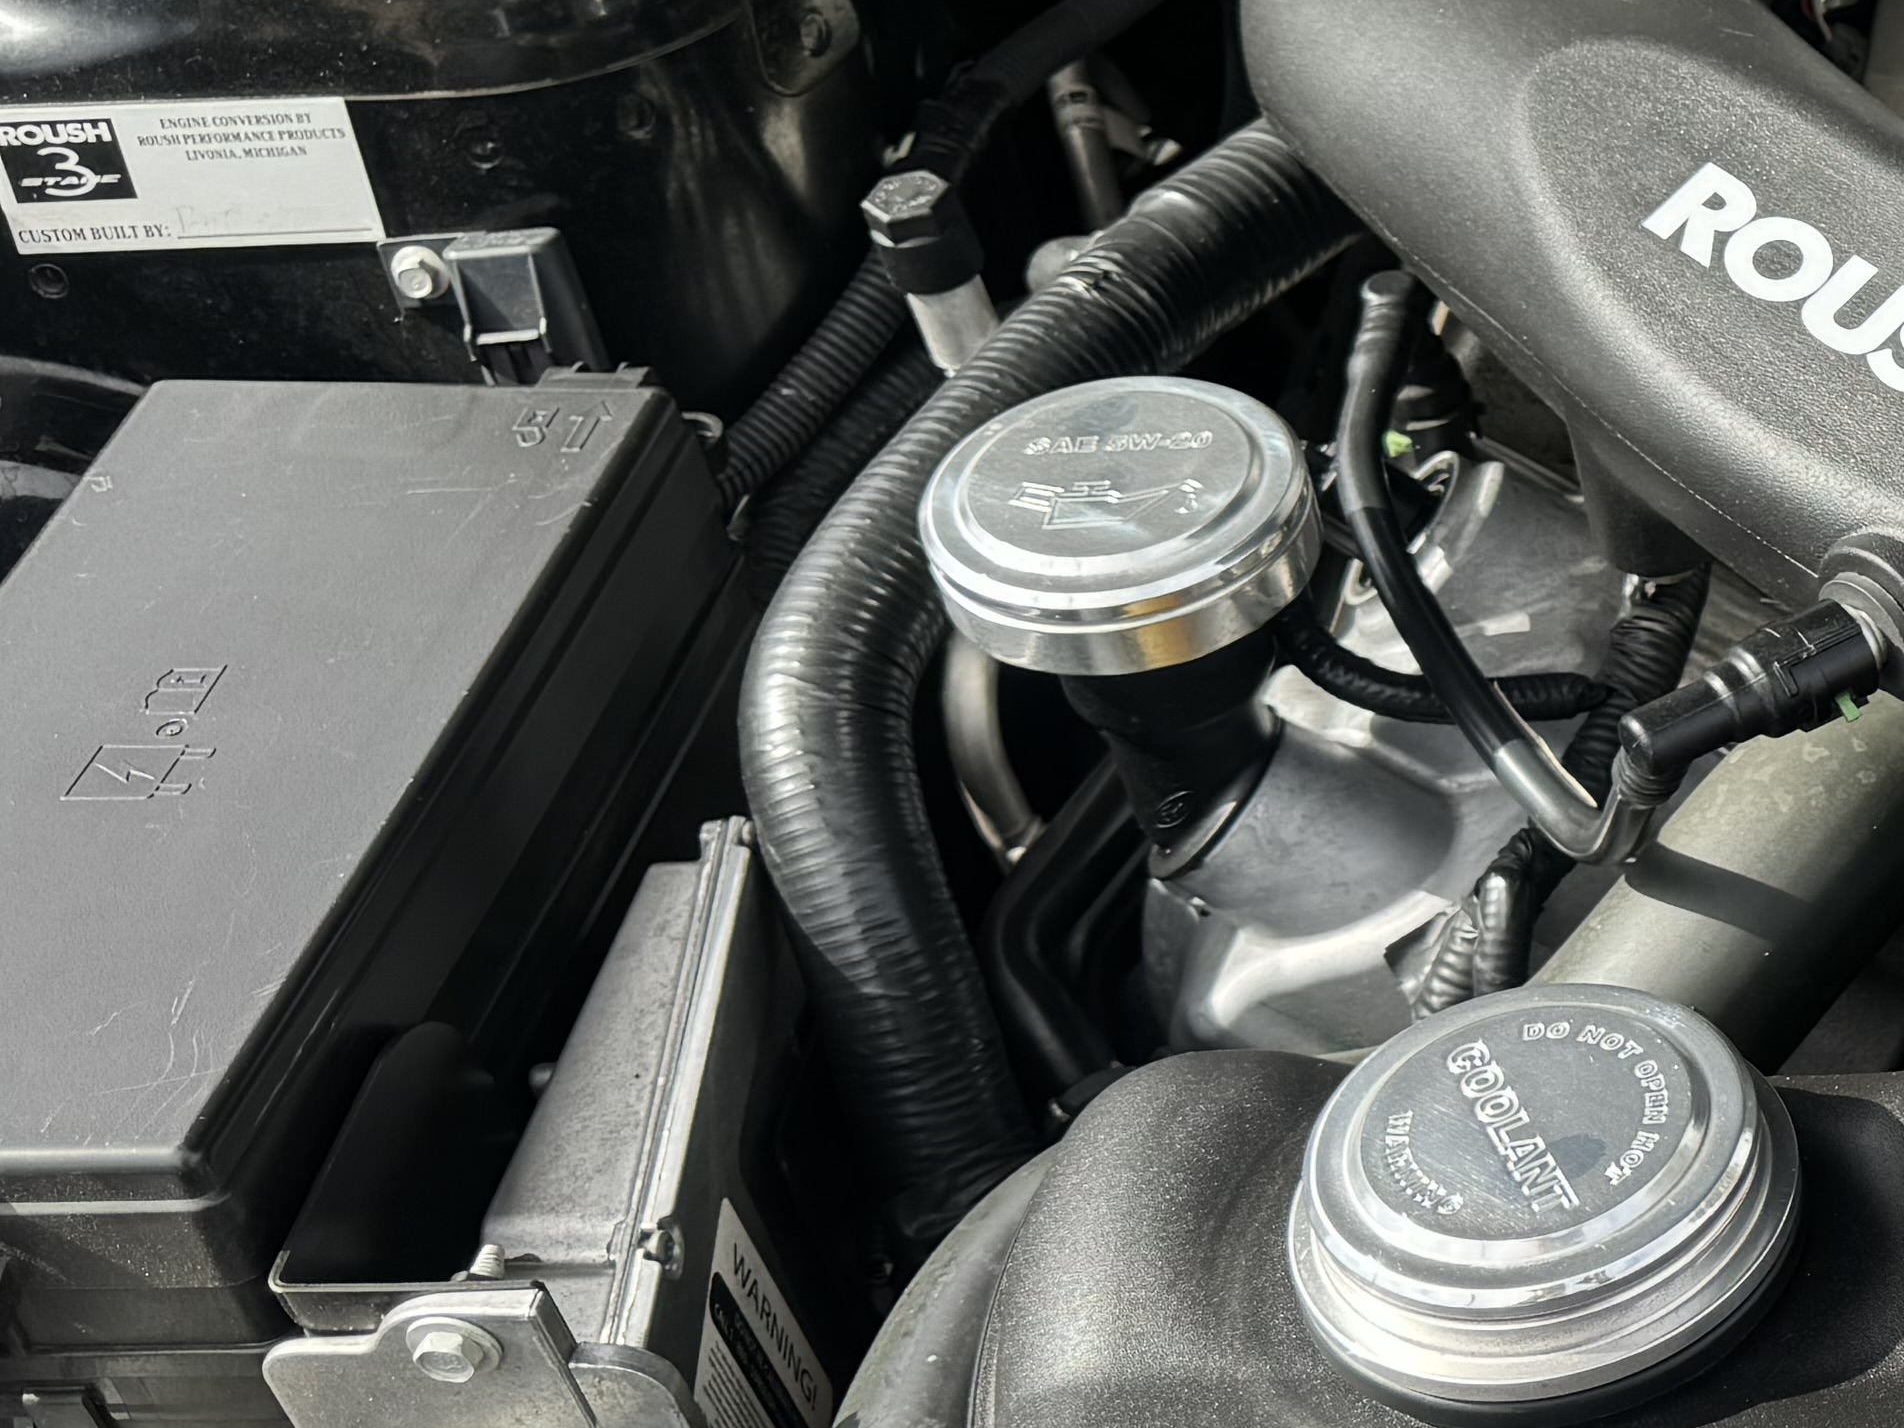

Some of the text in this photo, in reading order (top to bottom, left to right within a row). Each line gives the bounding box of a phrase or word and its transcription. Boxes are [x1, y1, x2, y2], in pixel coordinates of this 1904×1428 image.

[159, 113, 311, 130] ENGINE CONVERSION BY
[0, 121, 113, 147] ROUSH
[137, 127, 346, 146] ROUSH PERFORMANCE PRODUCTS
[185, 146, 308, 161] LIVONIA, MICHIGAN
[18, 224, 171, 244] CUSTOM BUILT BY:
[1023, 434, 1100, 456] SAE
[1523, 1021, 1570, 1042] DO
[1577, 1024, 1644, 1061] NOT
[1633, 1059, 1669, 1126] OPEN
[1446, 1036, 1580, 1213] COOLANT
[731, 1241, 820, 1414] WARNING!
